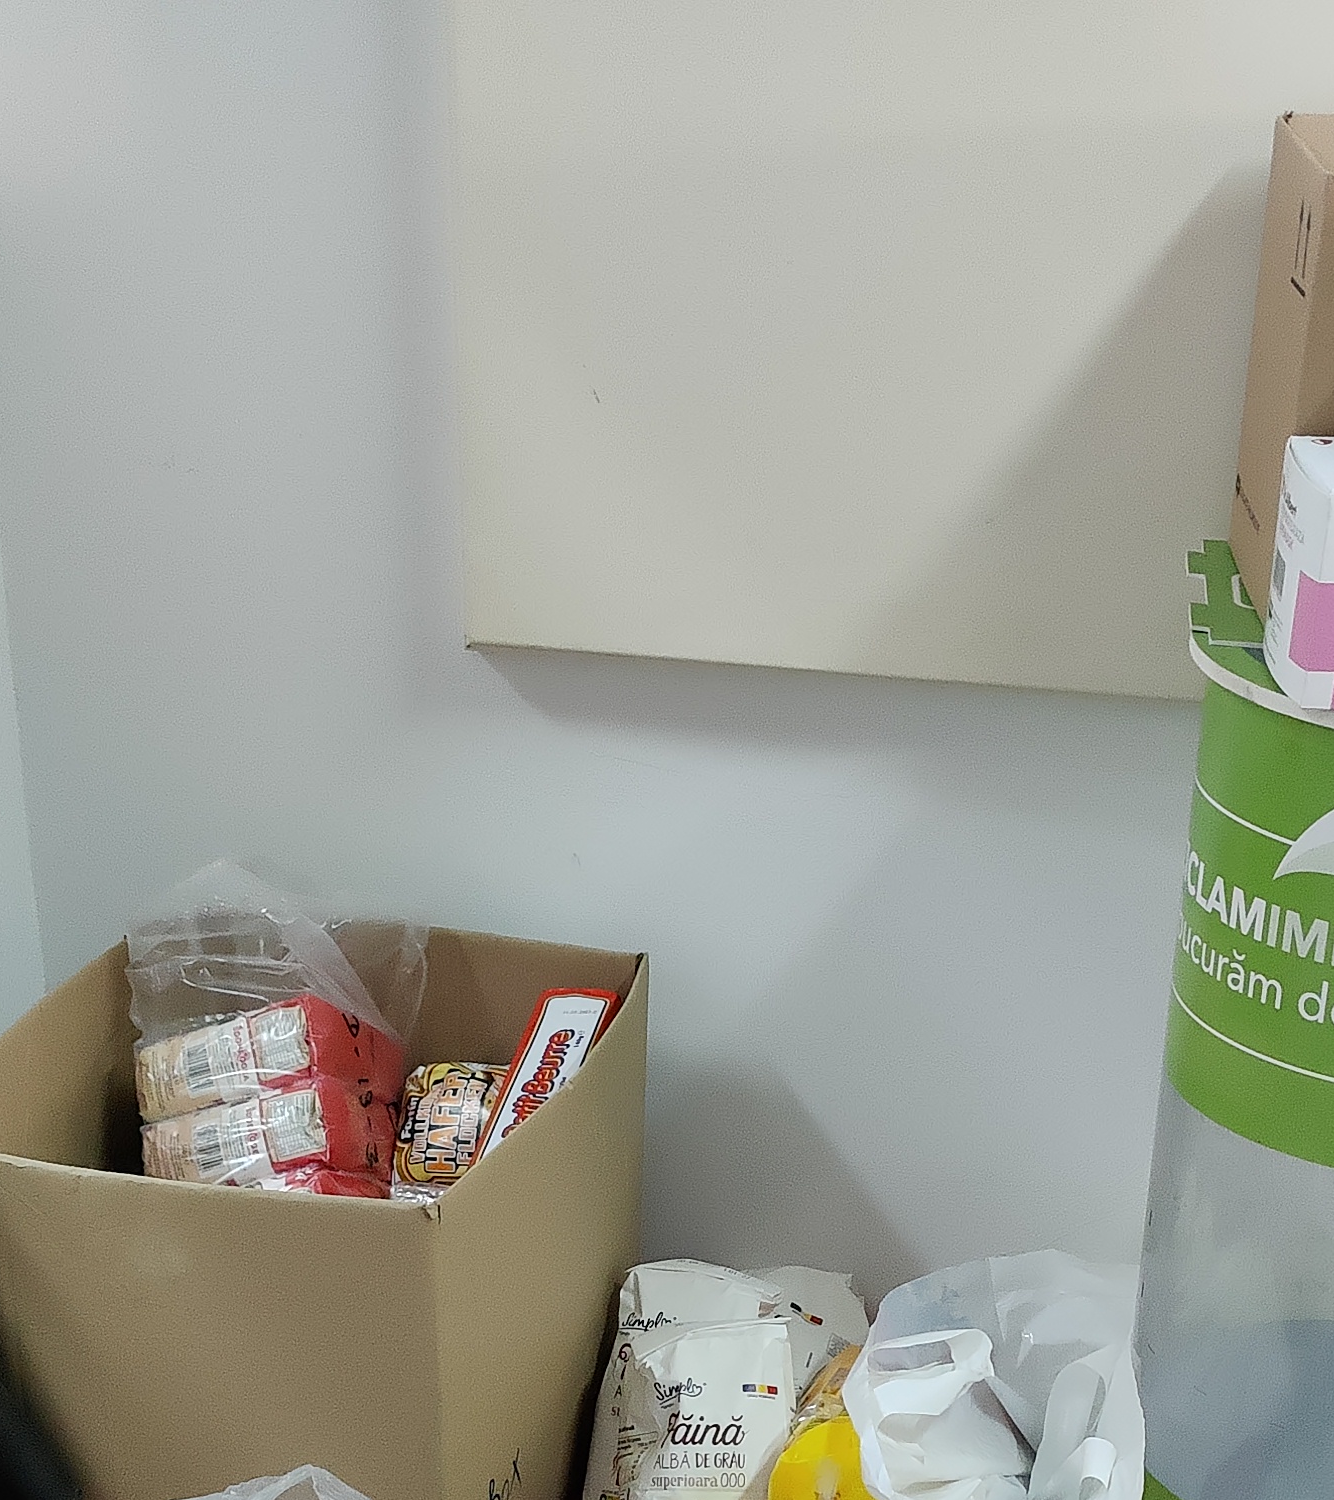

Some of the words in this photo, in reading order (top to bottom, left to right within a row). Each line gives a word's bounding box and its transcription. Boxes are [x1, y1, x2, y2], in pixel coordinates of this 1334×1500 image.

[528, 1027, 576, 1094] Beurre
[425, 1072, 468, 1174] HAFER
[695, 1452, 711, 1469] DE
